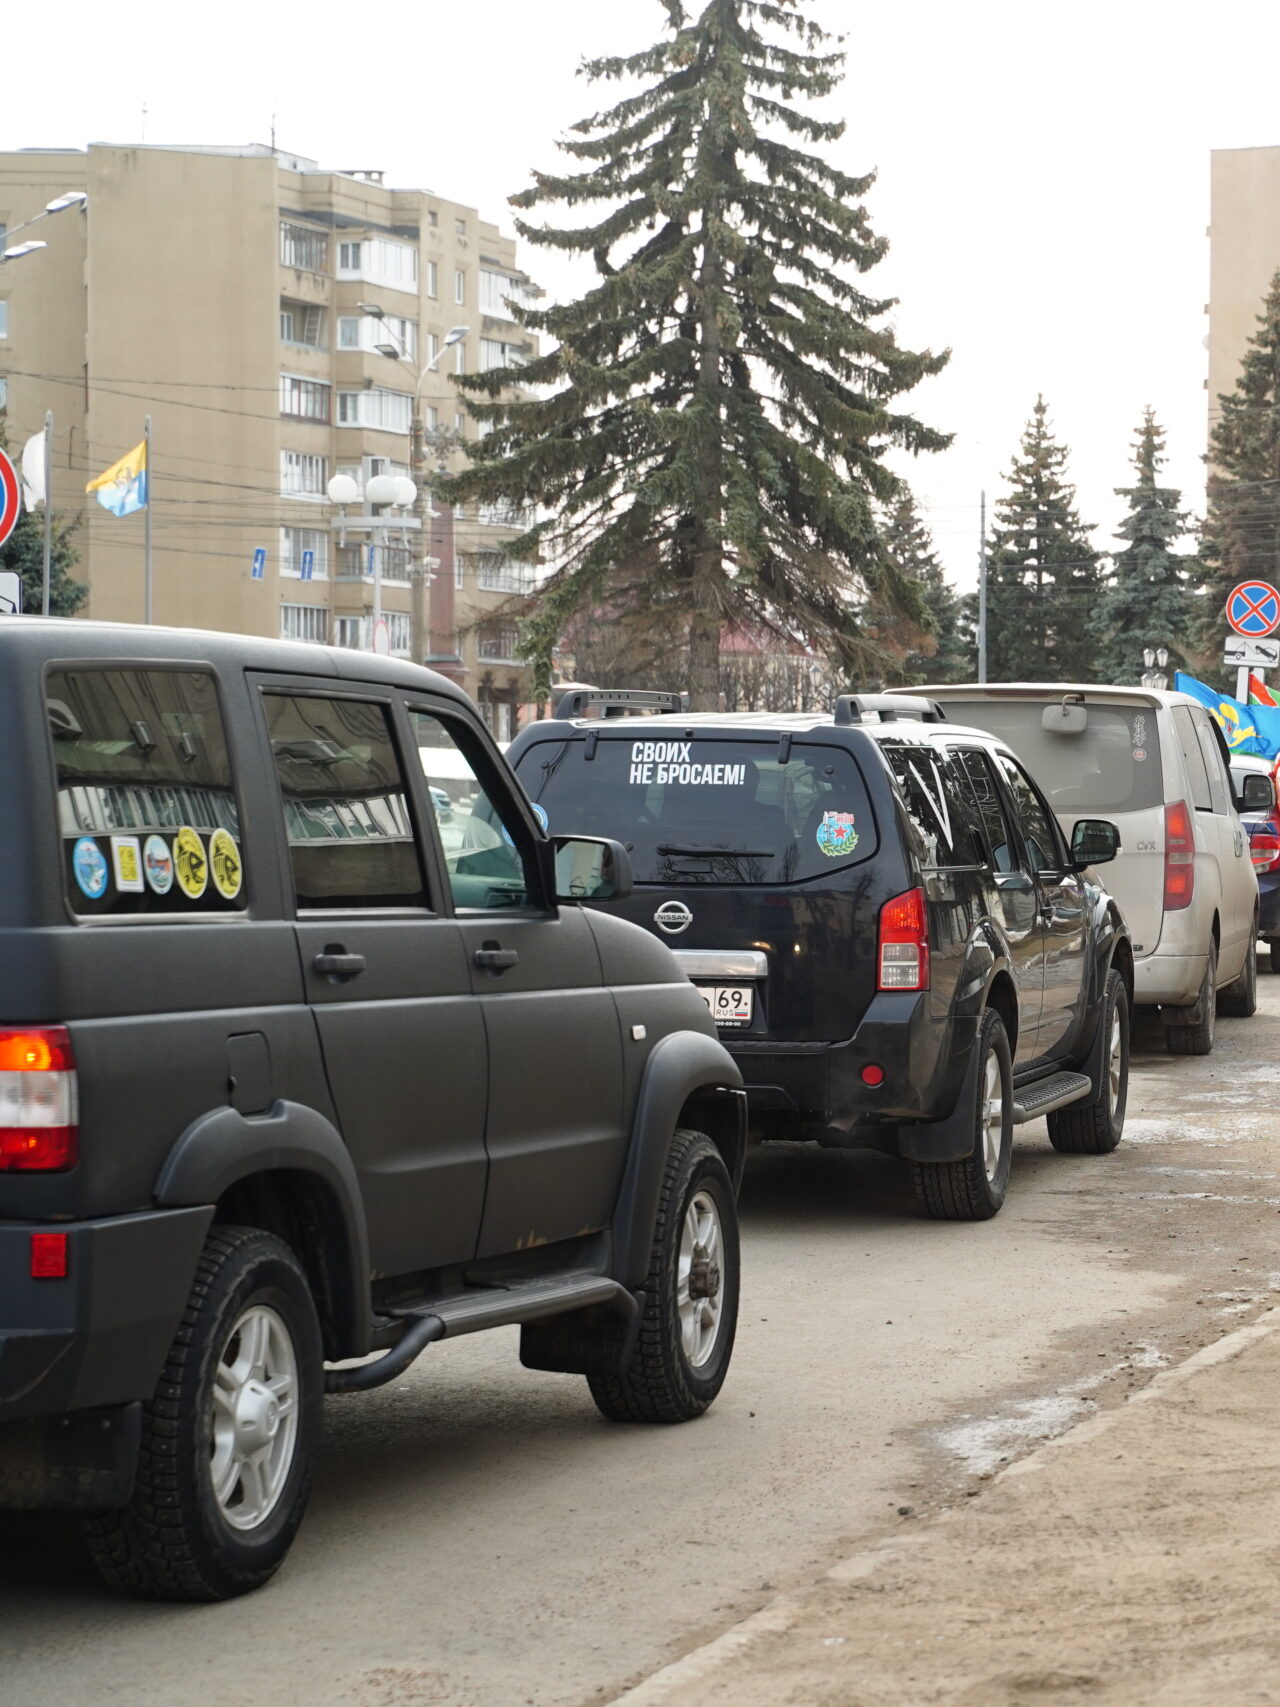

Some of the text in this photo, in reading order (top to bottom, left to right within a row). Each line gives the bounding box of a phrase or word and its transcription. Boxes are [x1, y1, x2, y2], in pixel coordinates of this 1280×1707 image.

[631, 742, 692, 763] СВОИХ
[629, 763, 746, 785] НЕ БРОСАЕМ!
[657, 913, 689, 921] NISSAN
[717, 989, 743, 1009] 69
[715, 1008, 734, 1017] RUS
